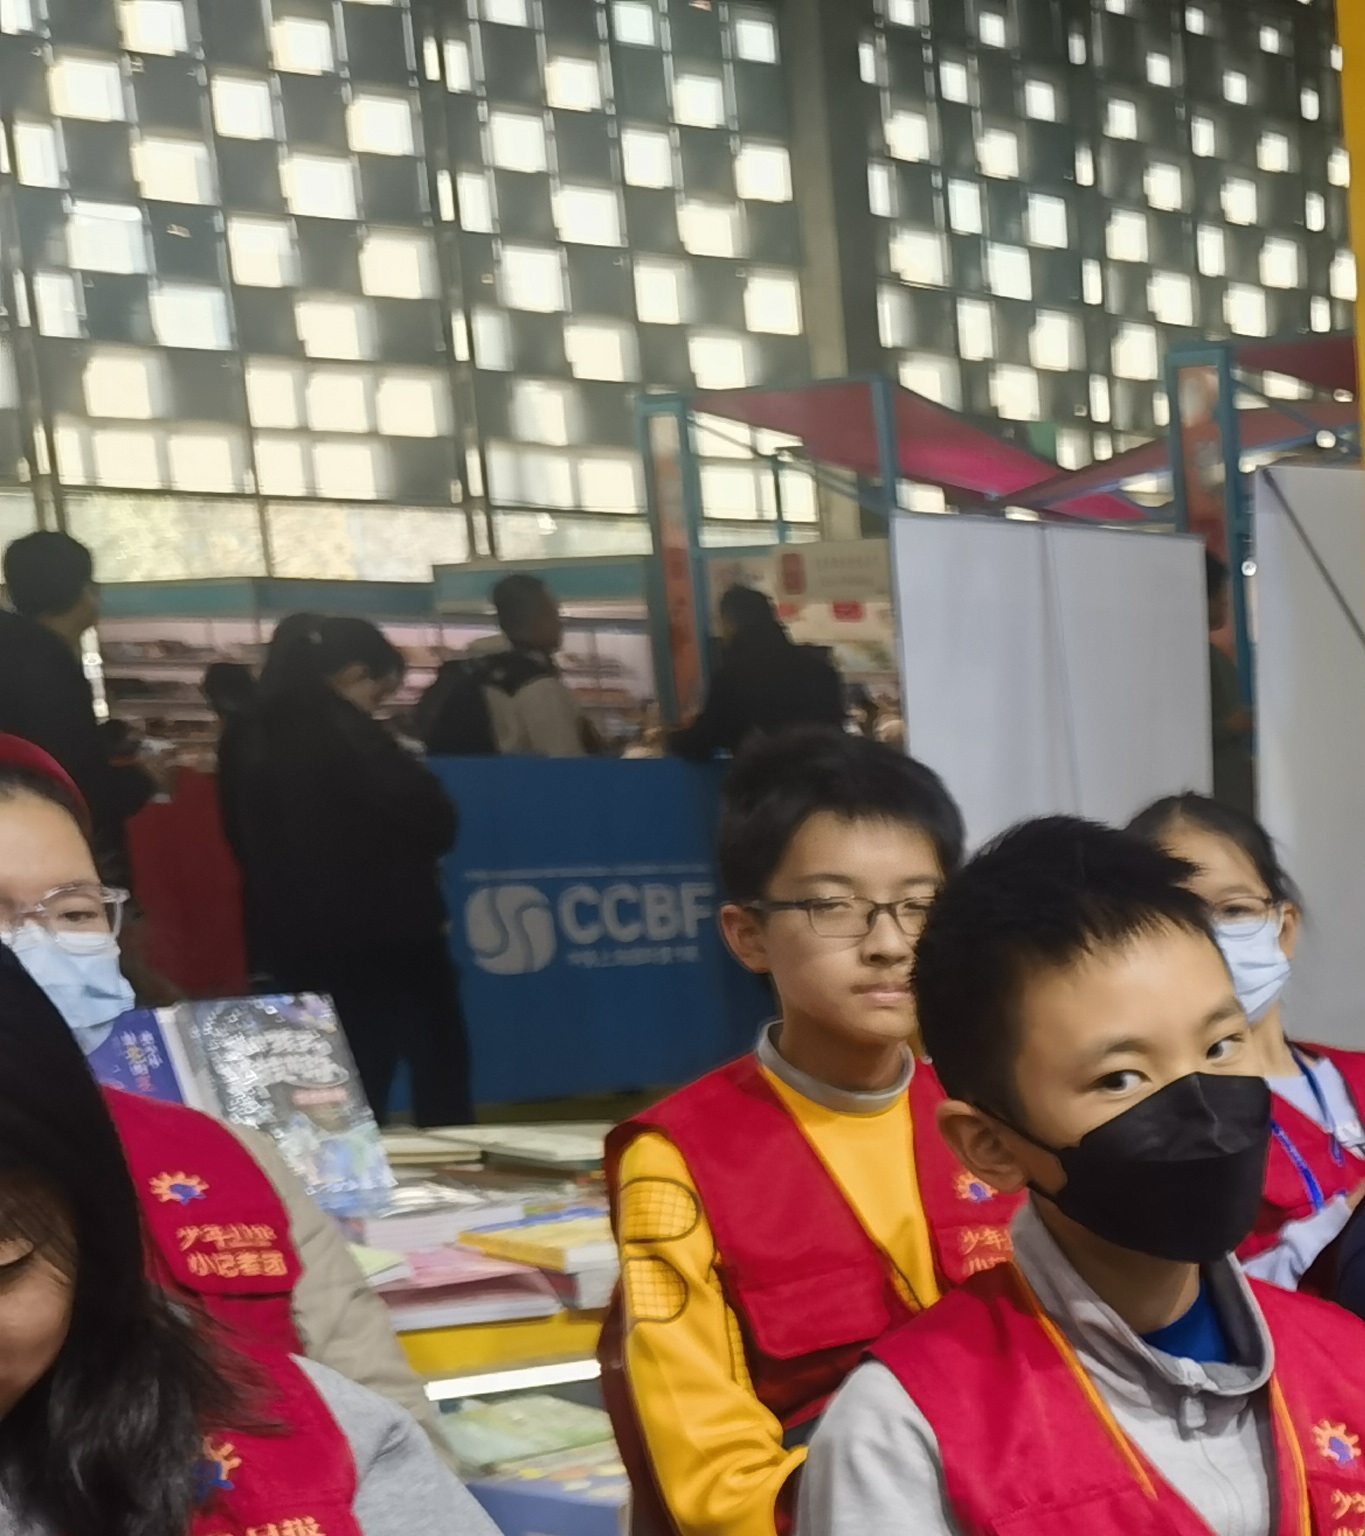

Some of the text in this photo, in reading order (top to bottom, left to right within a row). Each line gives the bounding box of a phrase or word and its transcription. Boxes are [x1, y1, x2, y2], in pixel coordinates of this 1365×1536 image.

[557, 882, 715, 945] CCBF
[187, 1250, 288, 1278] 小记者团
